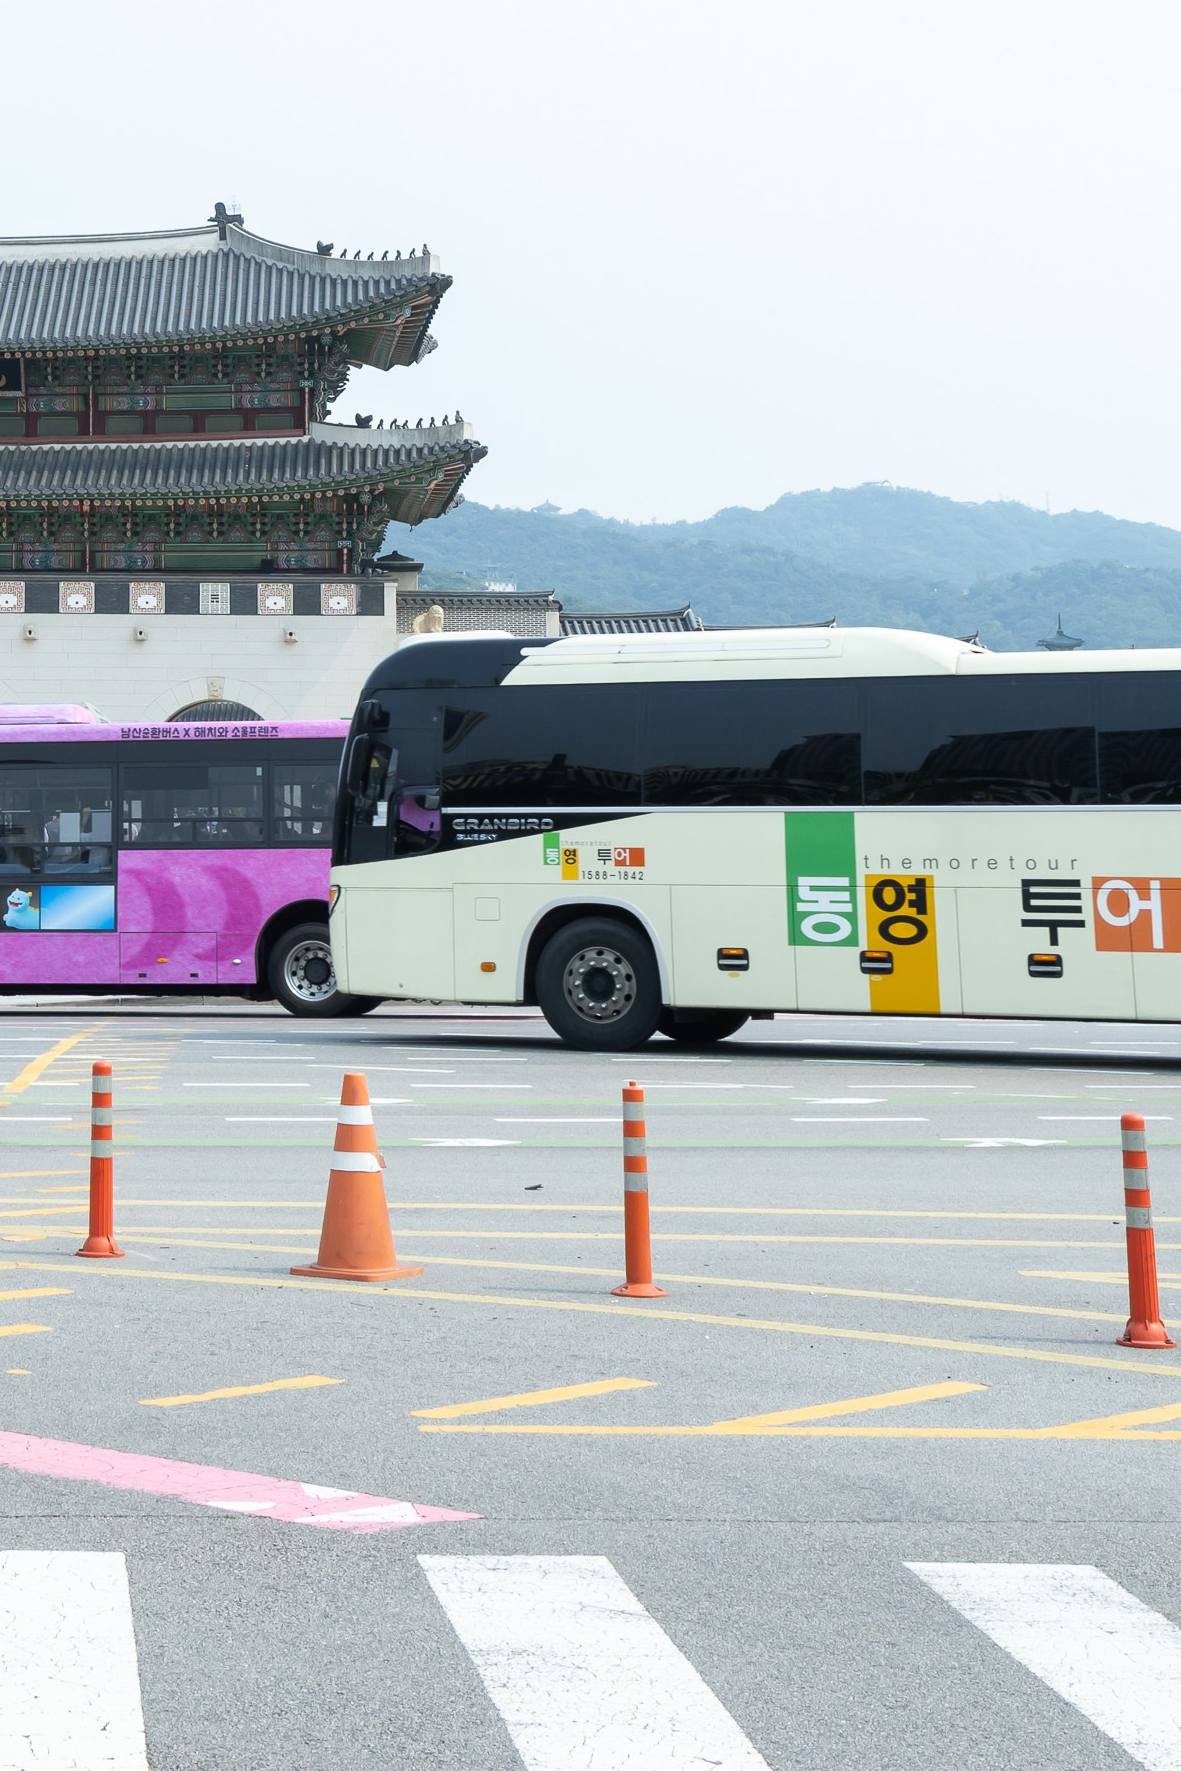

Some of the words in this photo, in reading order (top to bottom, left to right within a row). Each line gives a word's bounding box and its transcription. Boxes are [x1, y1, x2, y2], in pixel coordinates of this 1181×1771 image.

[121, 727, 180, 739] 남산순환버스
[183, 727, 191, 738] X
[194, 727, 228, 738] 해치와
[231, 726, 279, 738] 소울프렌즈
[452, 818, 554, 830] GRANBIRD
[863, 854, 1078, 871] themoretour
[581, 871, 644, 881] 1588-1842
